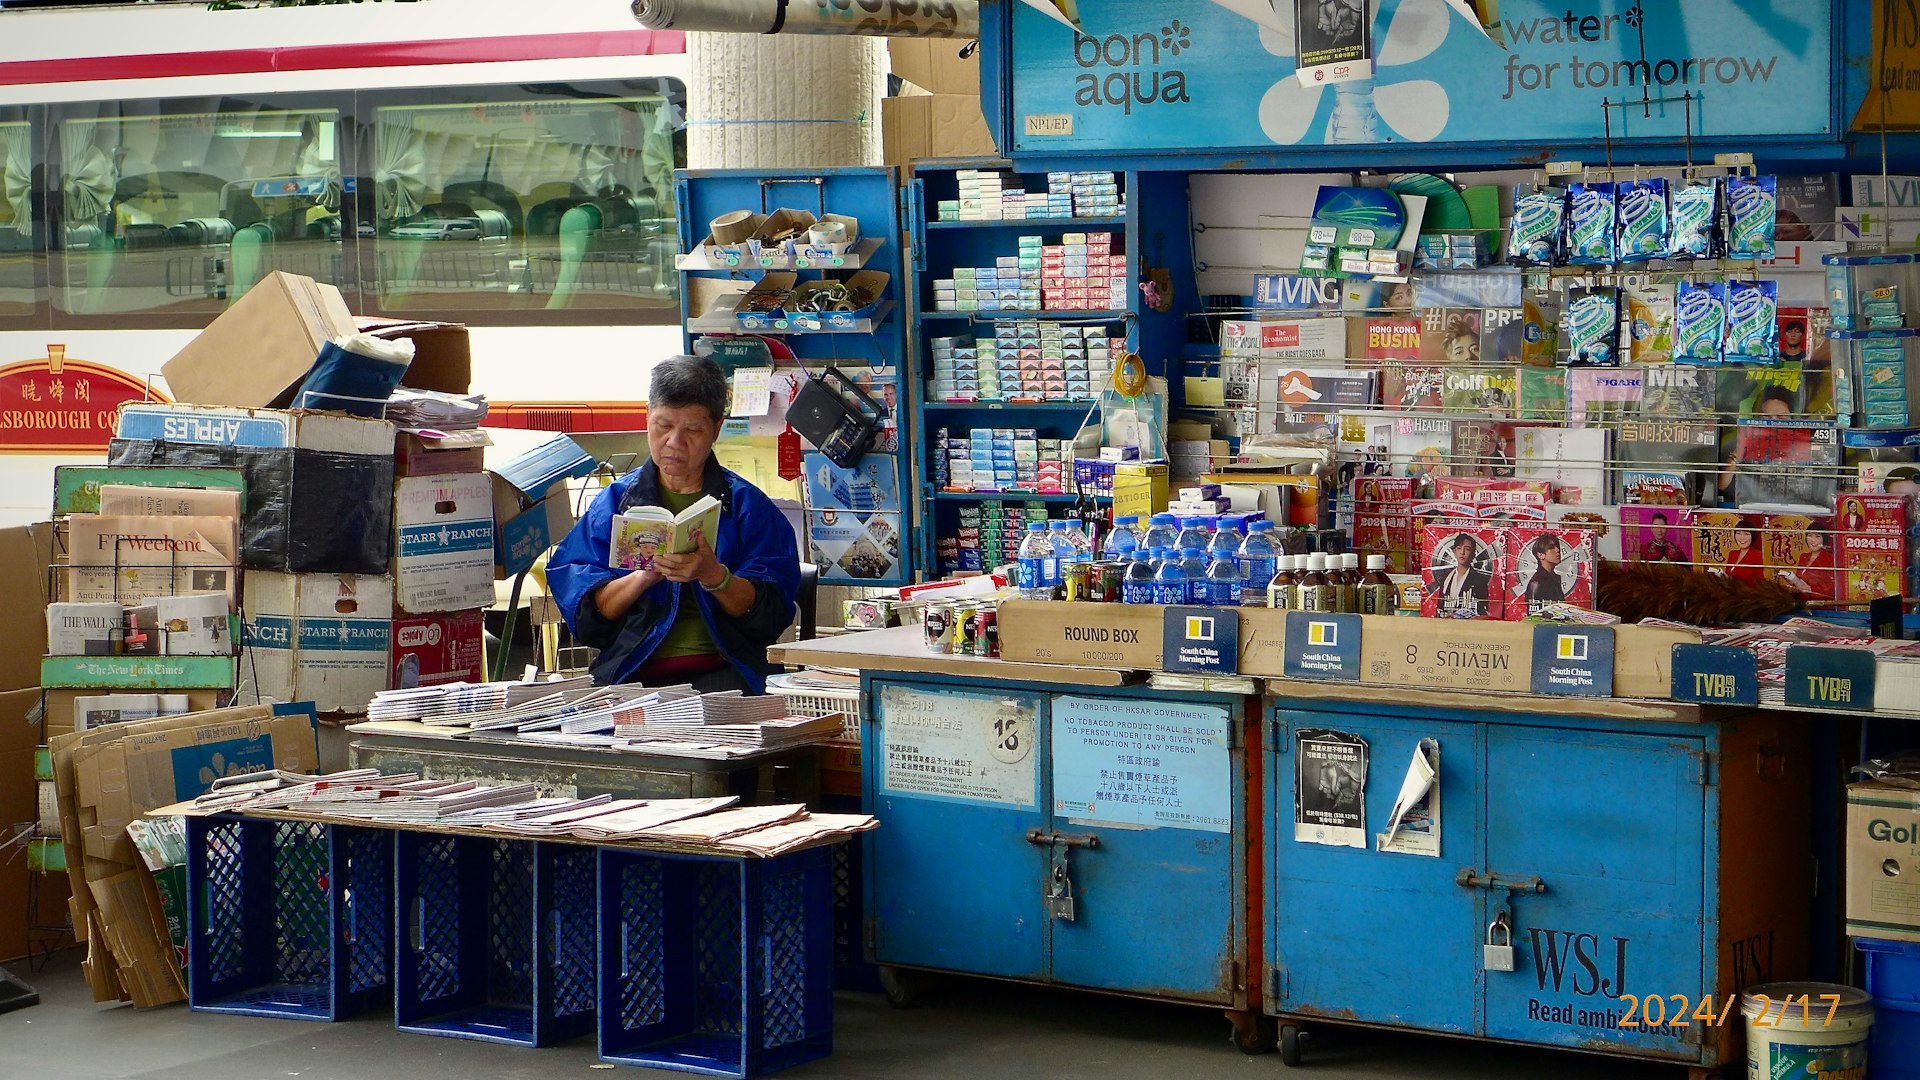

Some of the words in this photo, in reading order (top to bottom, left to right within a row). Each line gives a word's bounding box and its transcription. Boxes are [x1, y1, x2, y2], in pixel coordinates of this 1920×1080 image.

[1503, 10, 1620, 45] water
[1074, 30, 1160, 68] bon
[1502, 54, 1561, 100] for
[1569, 55, 1778, 89] tomorrow
[1074, 70, 1191, 115] aqua
[1029, 118, 1069, 133] NP1/EP
[1264, 277, 1339, 304] LIVING
[1370, 326, 1392, 334] HONG
[1393, 326, 1417, 334] KONG
[1263, 335, 1298, 344] Economist
[1446, 374, 1482, 391] Golf
[1648, 364, 1699, 387] MR
[0, 411, 90, 429] SBOROUGH
[1414, 418, 1449, 432] HEALTH
[164, 417, 240, 442] APPLES
[451, 486, 488, 500] APPLES
[1642, 484, 1663, 493] Digest
[399, 531, 437, 545] STARR
[451, 528, 491, 540] RANCH
[62, 616, 85, 628] THE
[87, 616, 107, 629] WALL
[299, 626, 336, 638] STARR
[351, 625, 389, 638] RANCH
[401, 629, 424, 643] Apples
[1064, 626, 1110, 643] ROUND
[1113, 628, 1140, 644] BOX
[1180, 646, 1199, 655] South
[1199, 646, 1218, 656] China
[1406, 644, 1418, 664] 8
[1443, 641, 1483, 651] MENTHOL
[1484, 643, 1511, 652] GREEN
[1178, 654, 1205, 665] Morning
[1205, 656, 1220, 665] Post
[1302, 652, 1322, 661] South
[1321, 653, 1341, 662] China
[1436, 650, 1510, 670] MEVIUS
[88, 663, 108, 675] The
[107, 664, 128, 675] New
[130, 664, 154, 678] York
[154, 664, 184, 676] Times
[1300, 661, 1328, 671] Morning
[1328, 661, 1343, 670] Post
[1549, 667, 1570, 677] South
[1570, 668, 1592, 678] China
[1548, 676, 1576, 687] Morning
[1576, 677, 1594, 686] Post
[1083, 703, 1110, 712] ORDER
[1125, 706, 1151, 716] HKSAR
[1154, 709, 1211, 721] GOVERNMENT:
[993, 718, 1019, 751] 18
[1078, 718, 1115, 728] TOBACCO
[1116, 721, 1153, 731] PRODUCT
[1155, 724, 1180, 733] SHALL
[1195, 728, 1216, 736] SOLD
[1080, 728, 1111, 737] PERSON
[1113, 730, 1140, 739] UNDER
[1142, 733, 1152, 741] 18
[1155, 734, 1167, 742] OR
[1169, 735, 1194, 744] GIVEN
[1196, 737, 1213, 746] FOR
[1083, 738, 1129, 749] PROMOTION
[1132, 742, 1142, 750] TO
[1145, 743, 1162, 752] ANY
[1164, 745, 1197, 755] PERSON
[1867, 818, 1920, 845] Gol
[1527, 927, 1631, 999] WSJ
[1528, 998, 1573, 1025] Read
